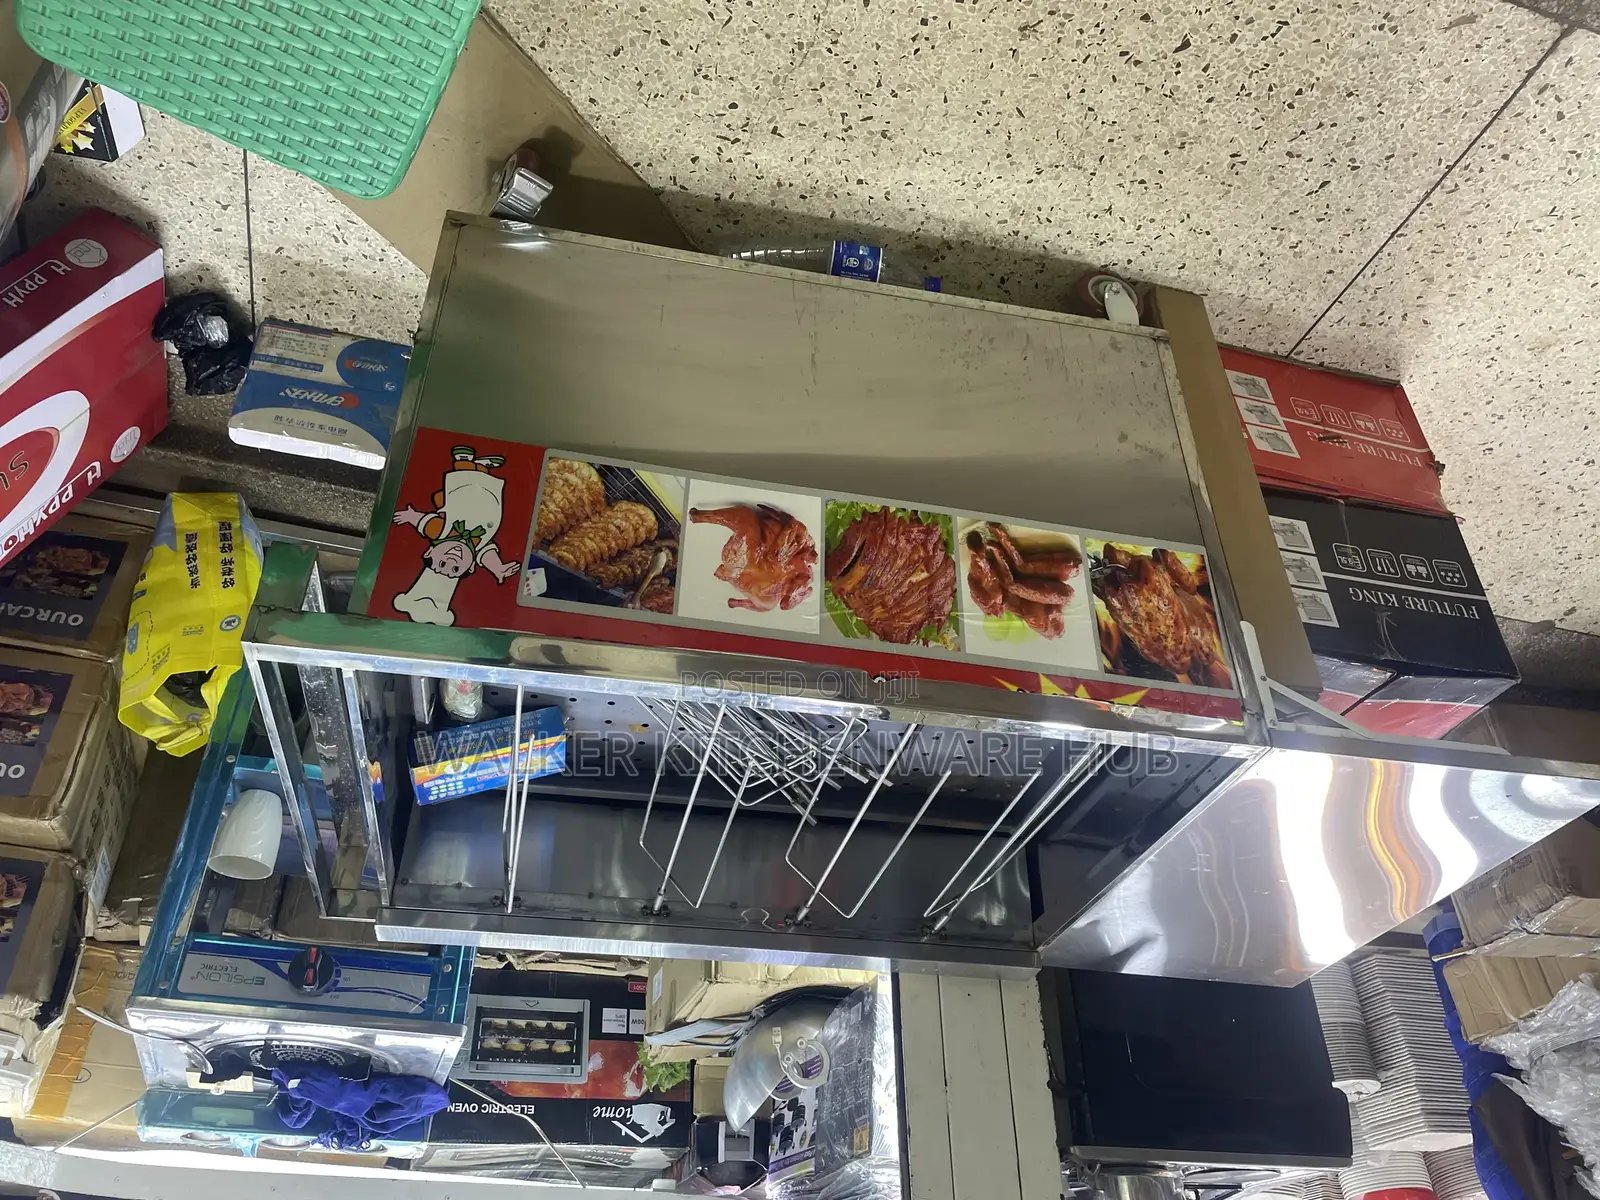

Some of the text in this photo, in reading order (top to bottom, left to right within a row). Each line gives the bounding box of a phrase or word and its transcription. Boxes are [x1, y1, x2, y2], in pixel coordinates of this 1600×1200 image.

[1354, 441, 1422, 467] FUTURE
[220, 556, 236, 589] 好老师
[1348, 588, 1480, 620] FUTURE KING
[196, 970, 266, 986] EPSILON
[200, 963, 238, 972] ELECTRIC
[446, 1102, 535, 1114] ELECTRIC OVEN
